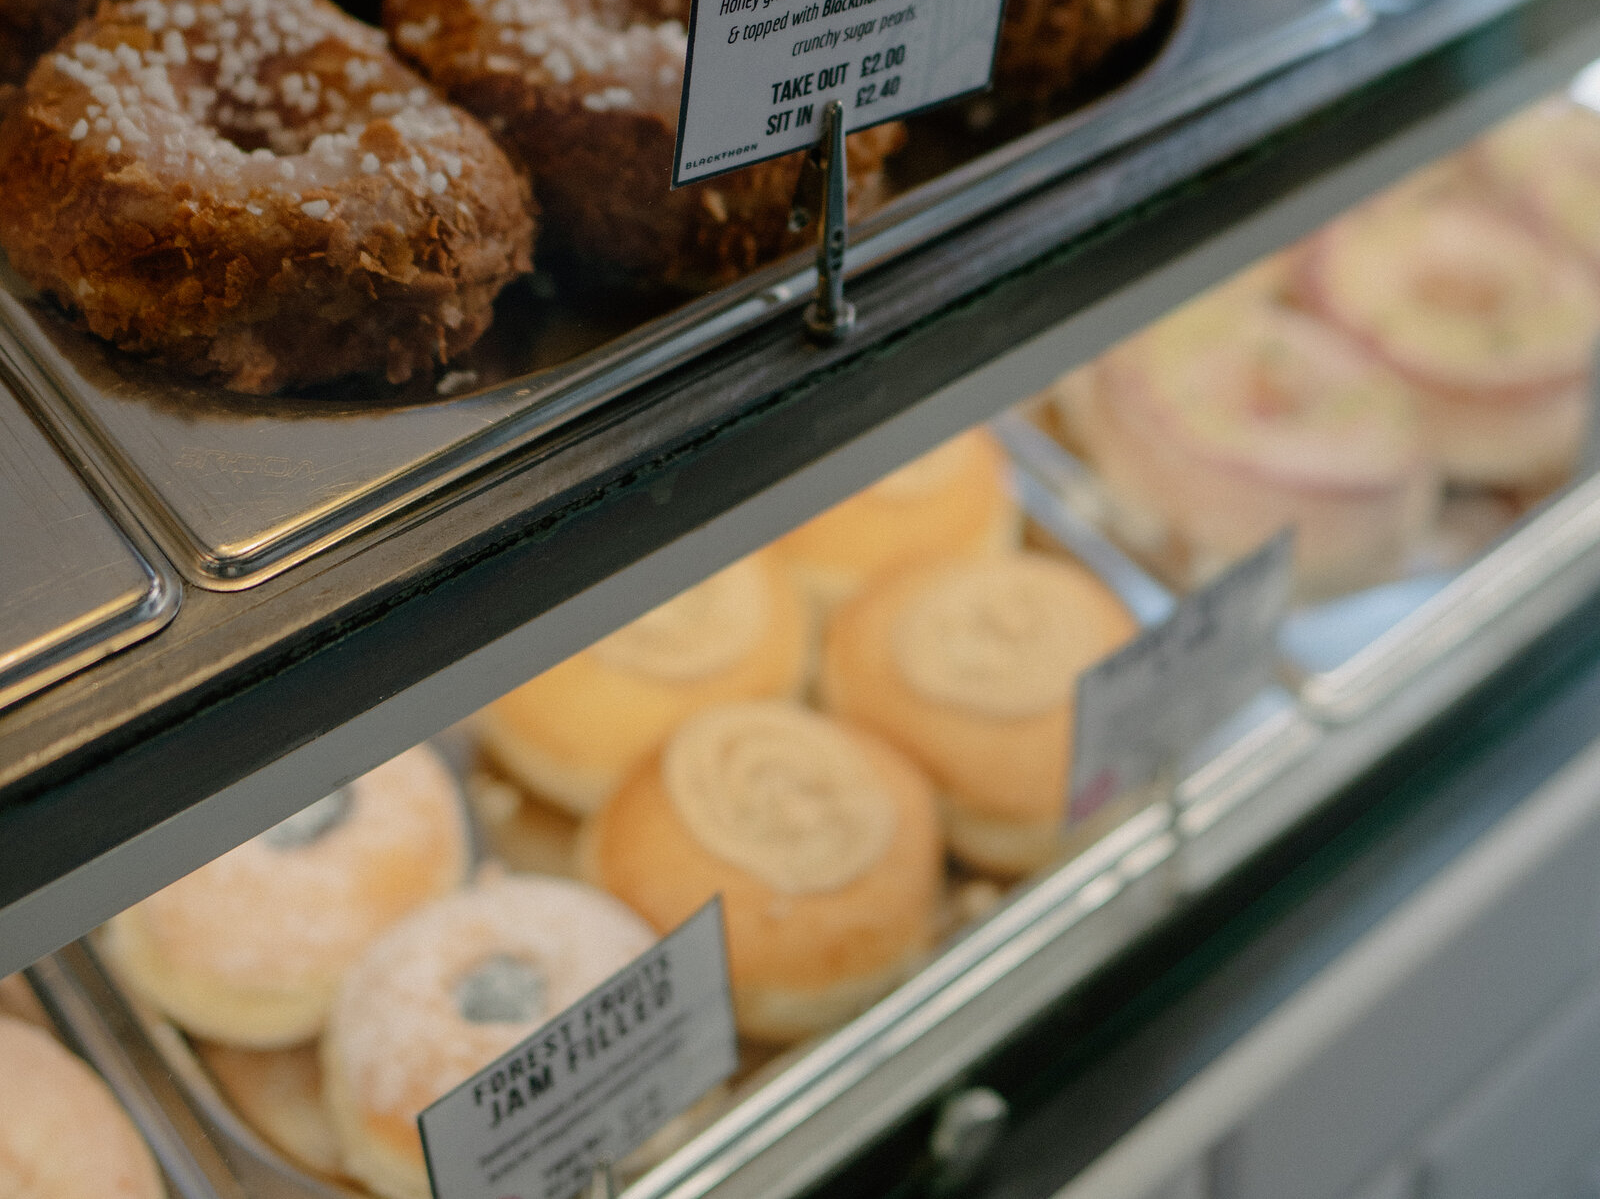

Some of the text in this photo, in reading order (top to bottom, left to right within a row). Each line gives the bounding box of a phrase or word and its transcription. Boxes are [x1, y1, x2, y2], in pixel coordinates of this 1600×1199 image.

[727, 25, 741, 45] &
[742, 10, 790, 42] topped
[791, 4, 820, 27] with
[791, 28, 841, 57] crunchy
[842, 17, 877, 43] sugar
[764, 75, 903, 137] SIT IN £2.40
[770, 44, 907, 106] TAKE OUT £2.00
[685, 143, 760, 171] BLACKTHORN
[474, 1020, 573, 1105] FOREST
[492, 1064, 556, 1129] JAM
[566, 979, 673, 1074] FILLED
